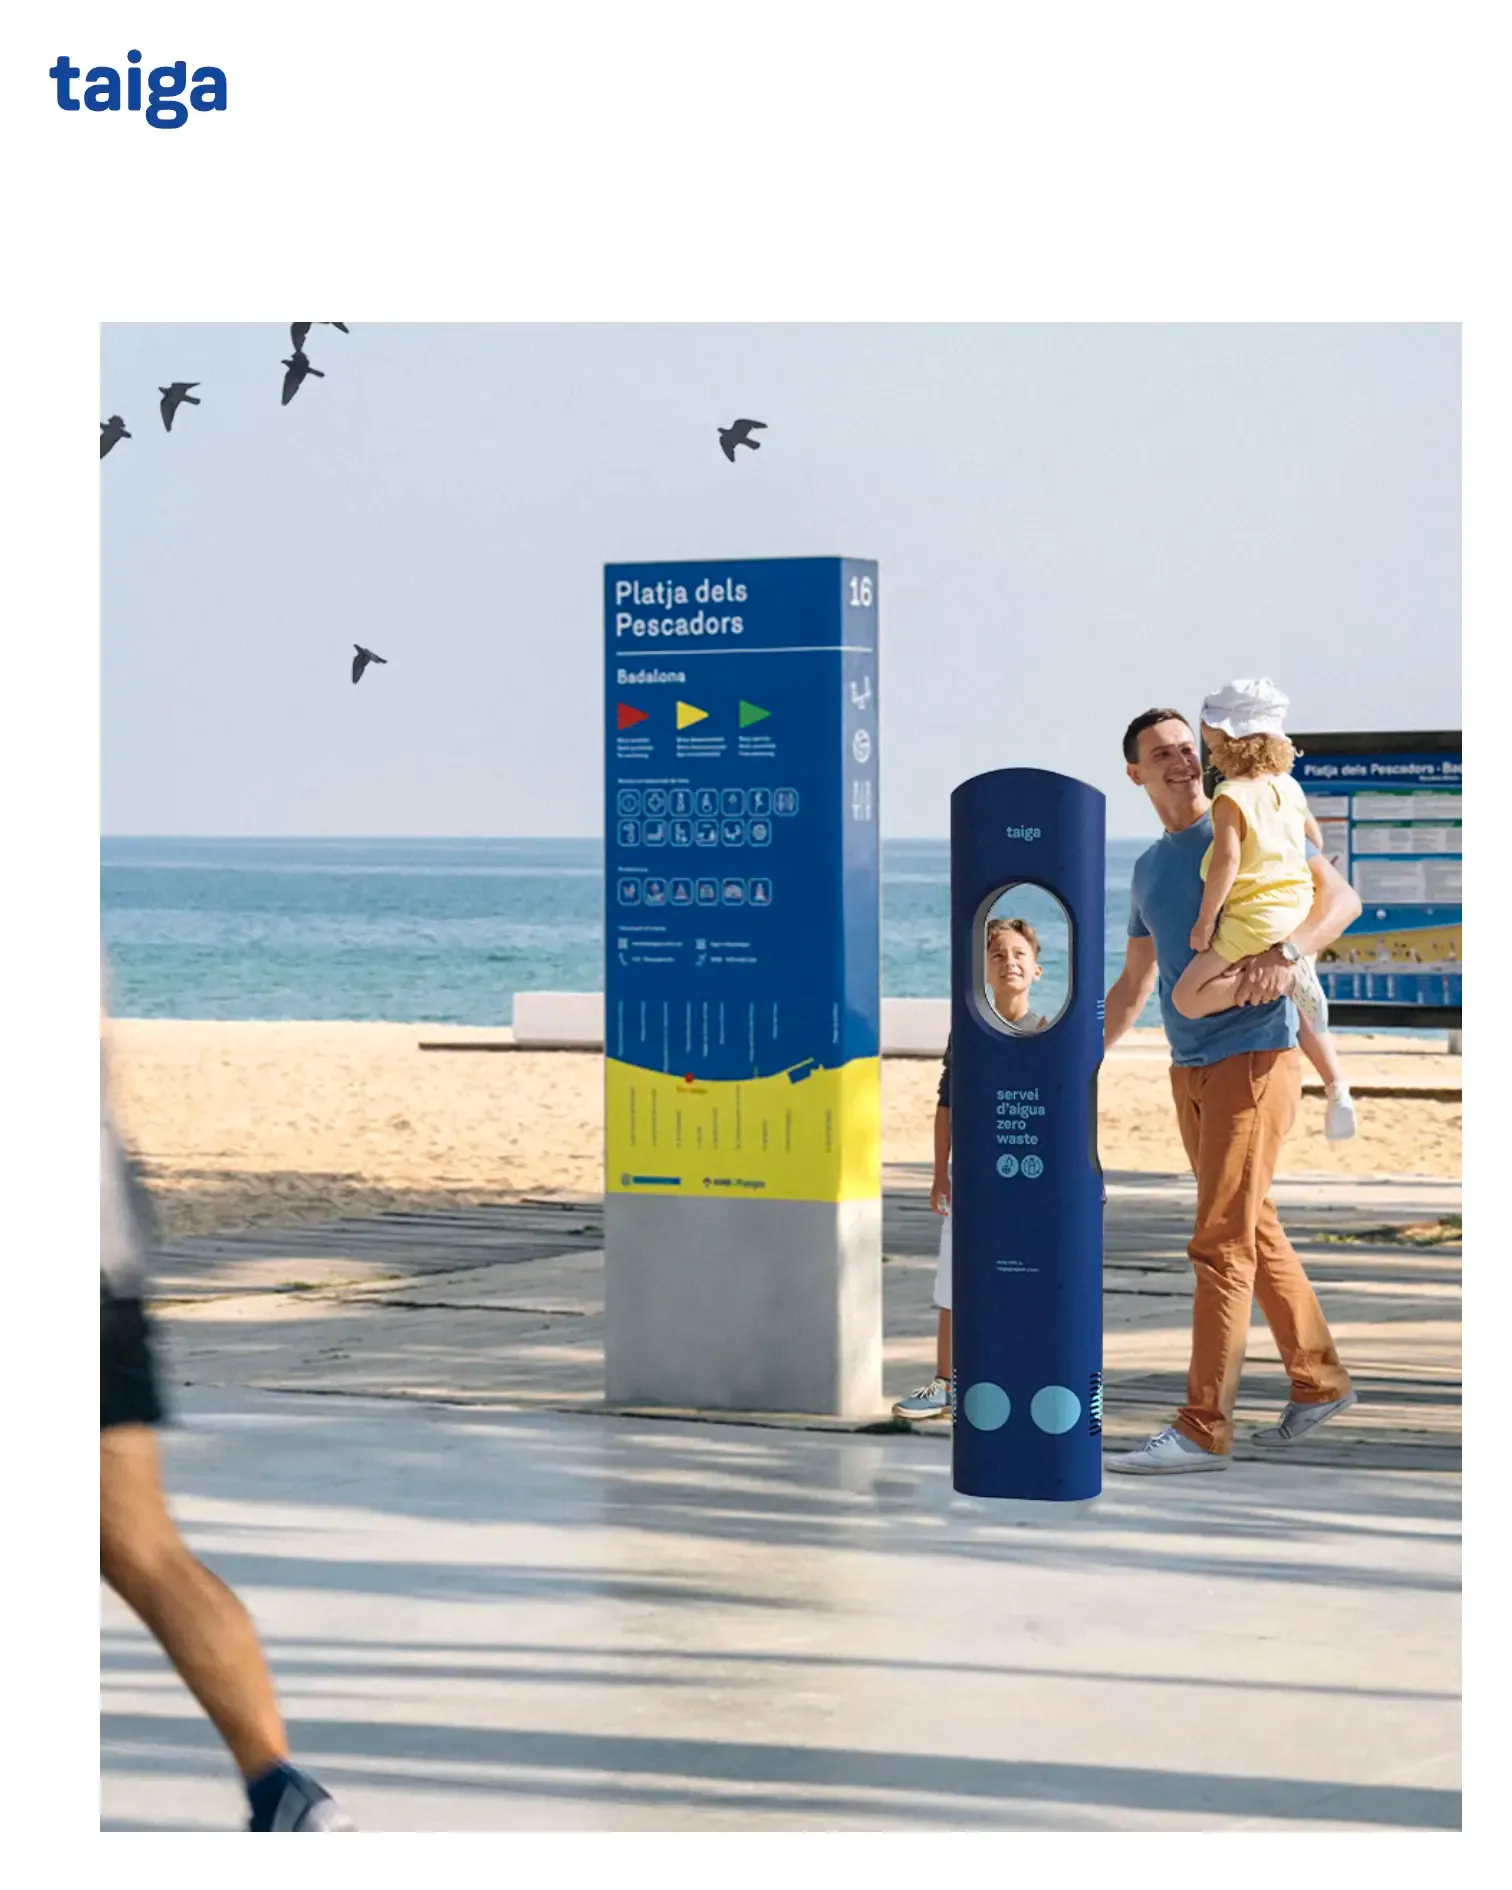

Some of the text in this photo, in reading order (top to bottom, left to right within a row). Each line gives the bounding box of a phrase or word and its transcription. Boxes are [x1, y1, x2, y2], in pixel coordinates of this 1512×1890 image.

[616, 578, 749, 610] Platja dels
[849, 576, 874, 607] 16
[616, 610, 744, 637] Pescadors
[616, 669, 686, 684] Badalona
[1006, 825, 1041, 841] taiga
[996, 1088, 1039, 1100] servei
[996, 1119, 1027, 1130] zero
[996, 1134, 1039, 1145] waste
